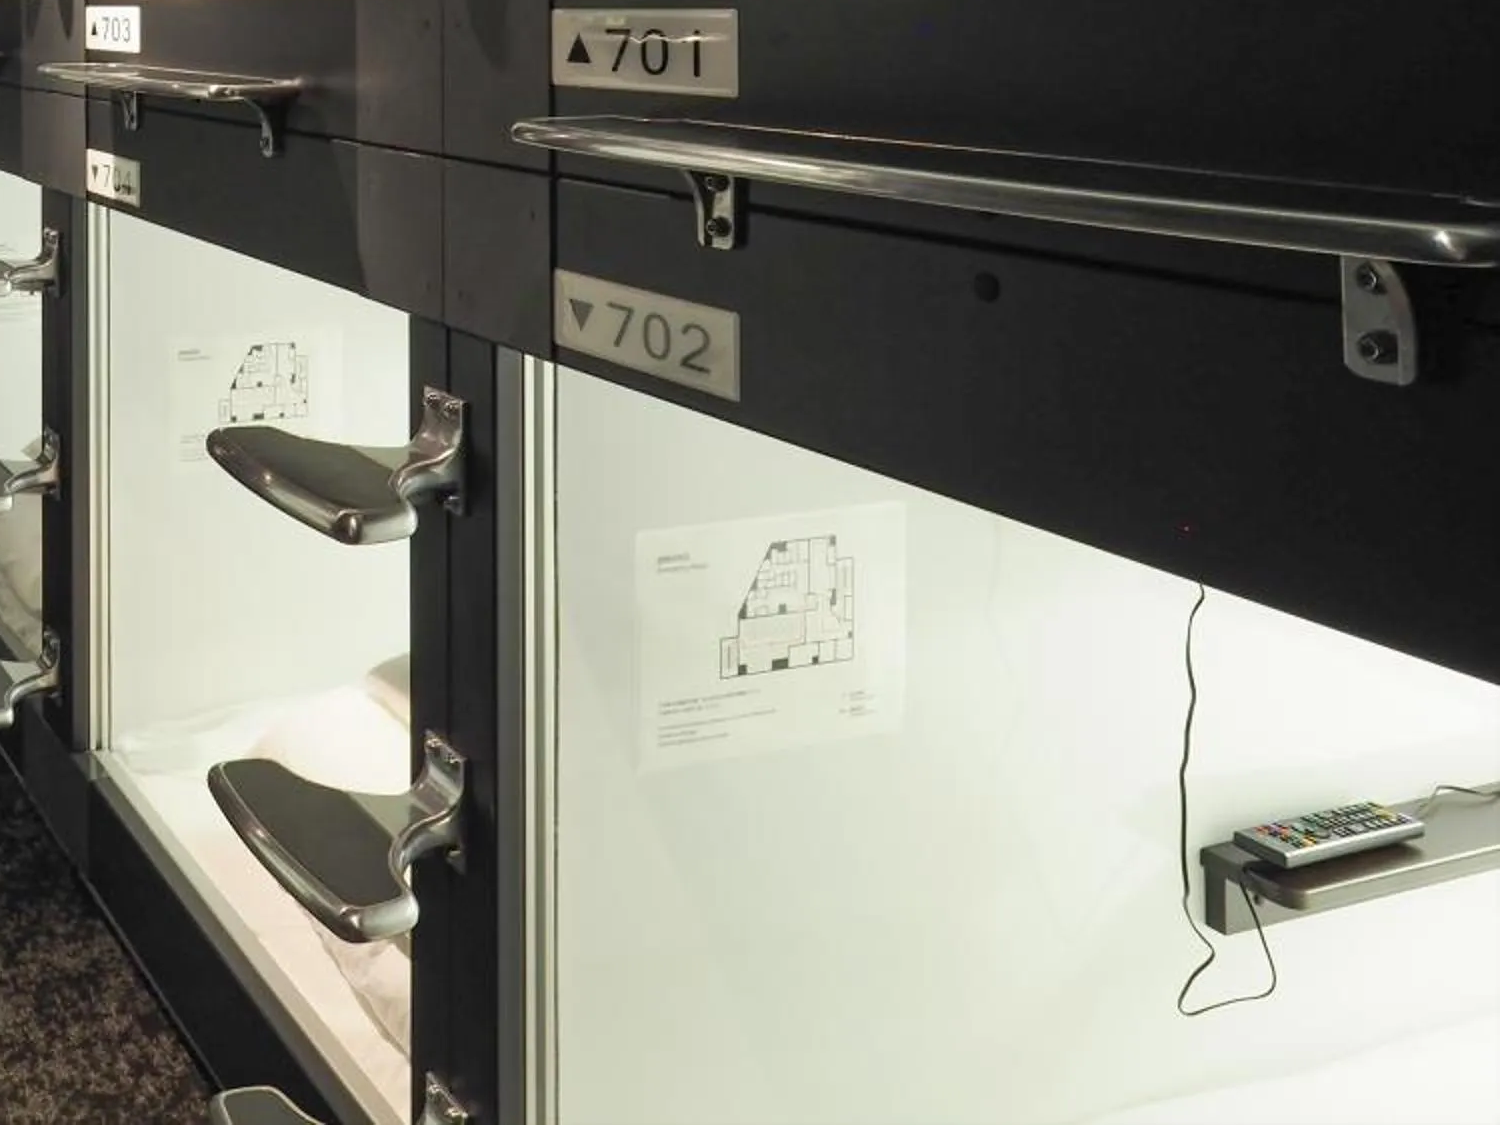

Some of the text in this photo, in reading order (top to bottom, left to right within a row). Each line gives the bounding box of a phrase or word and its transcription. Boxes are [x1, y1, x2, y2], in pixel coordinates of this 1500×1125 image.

[101, 16, 131, 44] 703
[604, 27, 702, 78] 701
[102, 164, 132, 195] 704
[606, 300, 711, 375] 702
